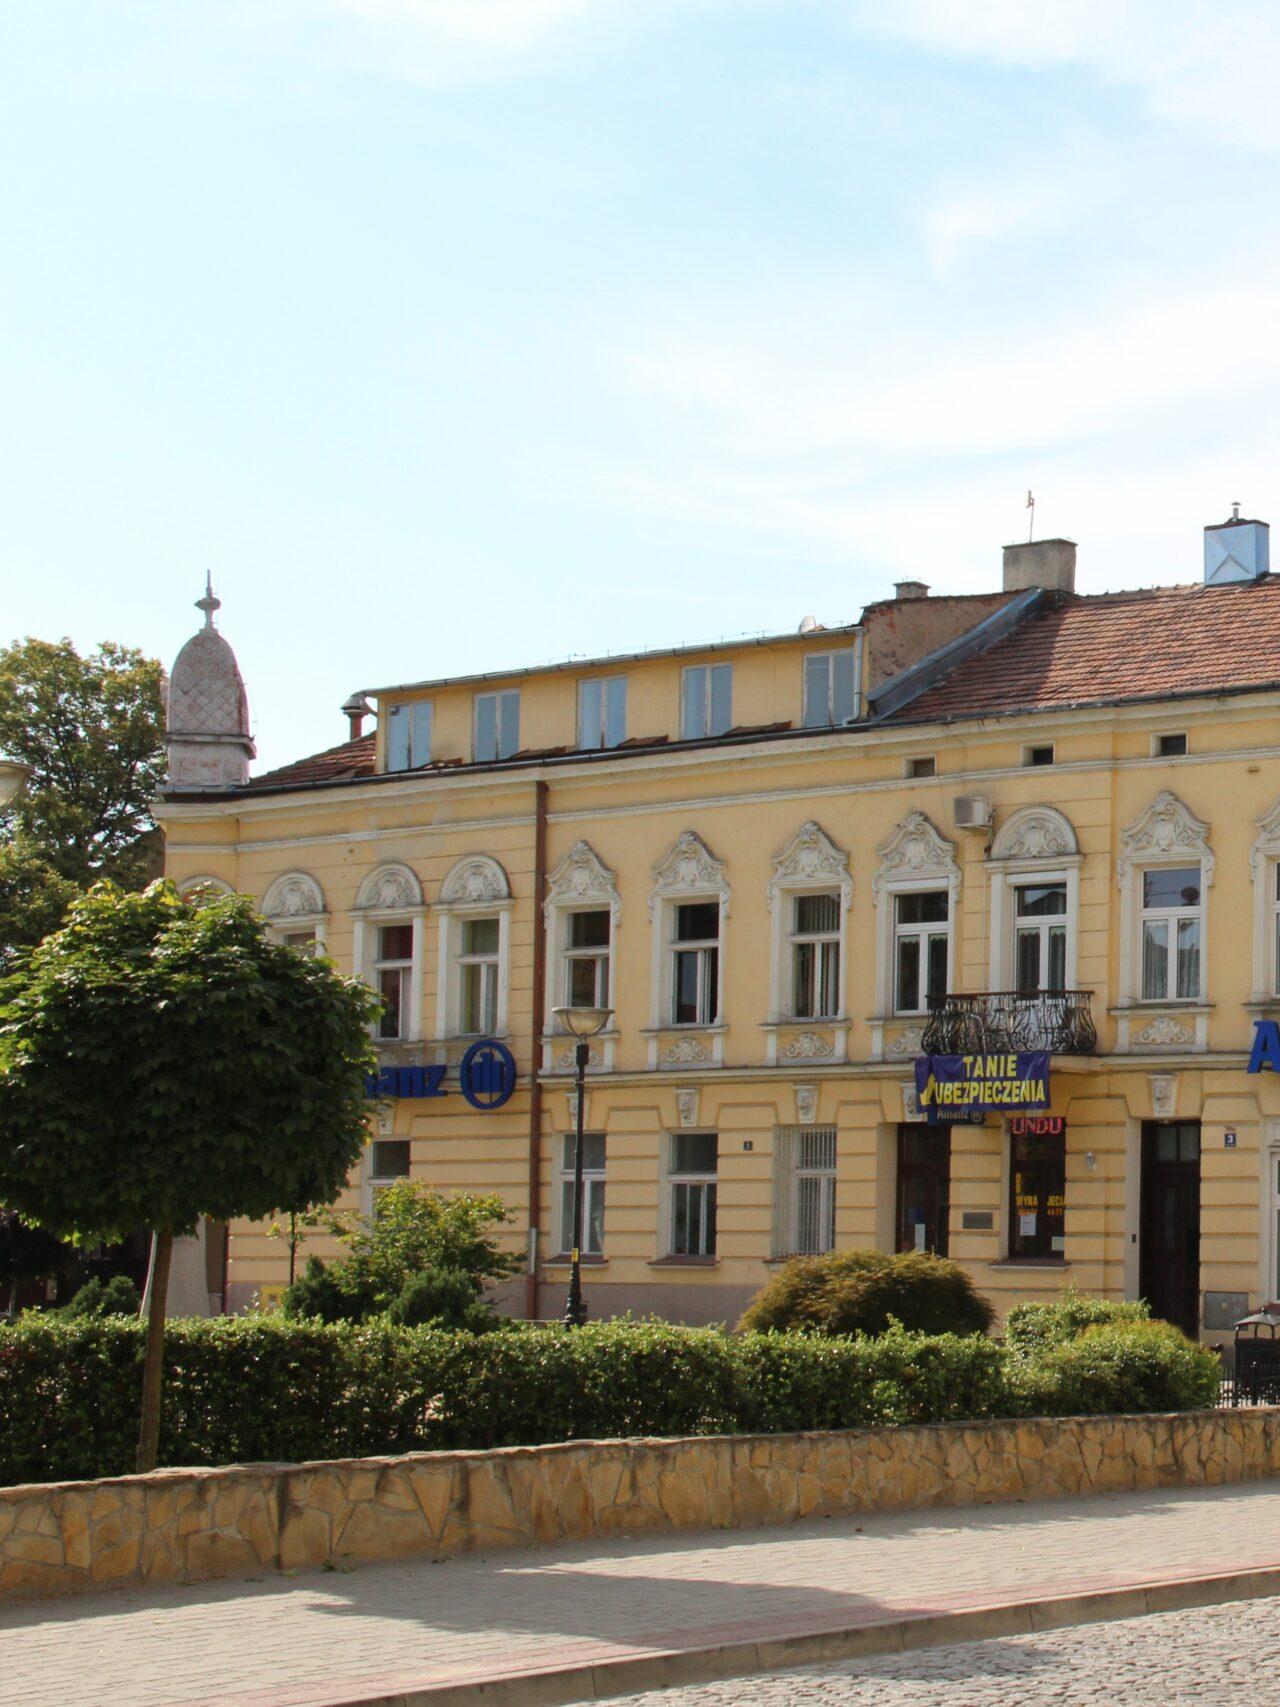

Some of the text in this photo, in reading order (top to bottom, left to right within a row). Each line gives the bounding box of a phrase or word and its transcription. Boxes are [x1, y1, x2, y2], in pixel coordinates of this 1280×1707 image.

[963, 1055, 1018, 1077] TANIE
[935, 1080, 1045, 1104] UBEZPIECZENIA
[1226, 1134, 1234, 1144] 3
